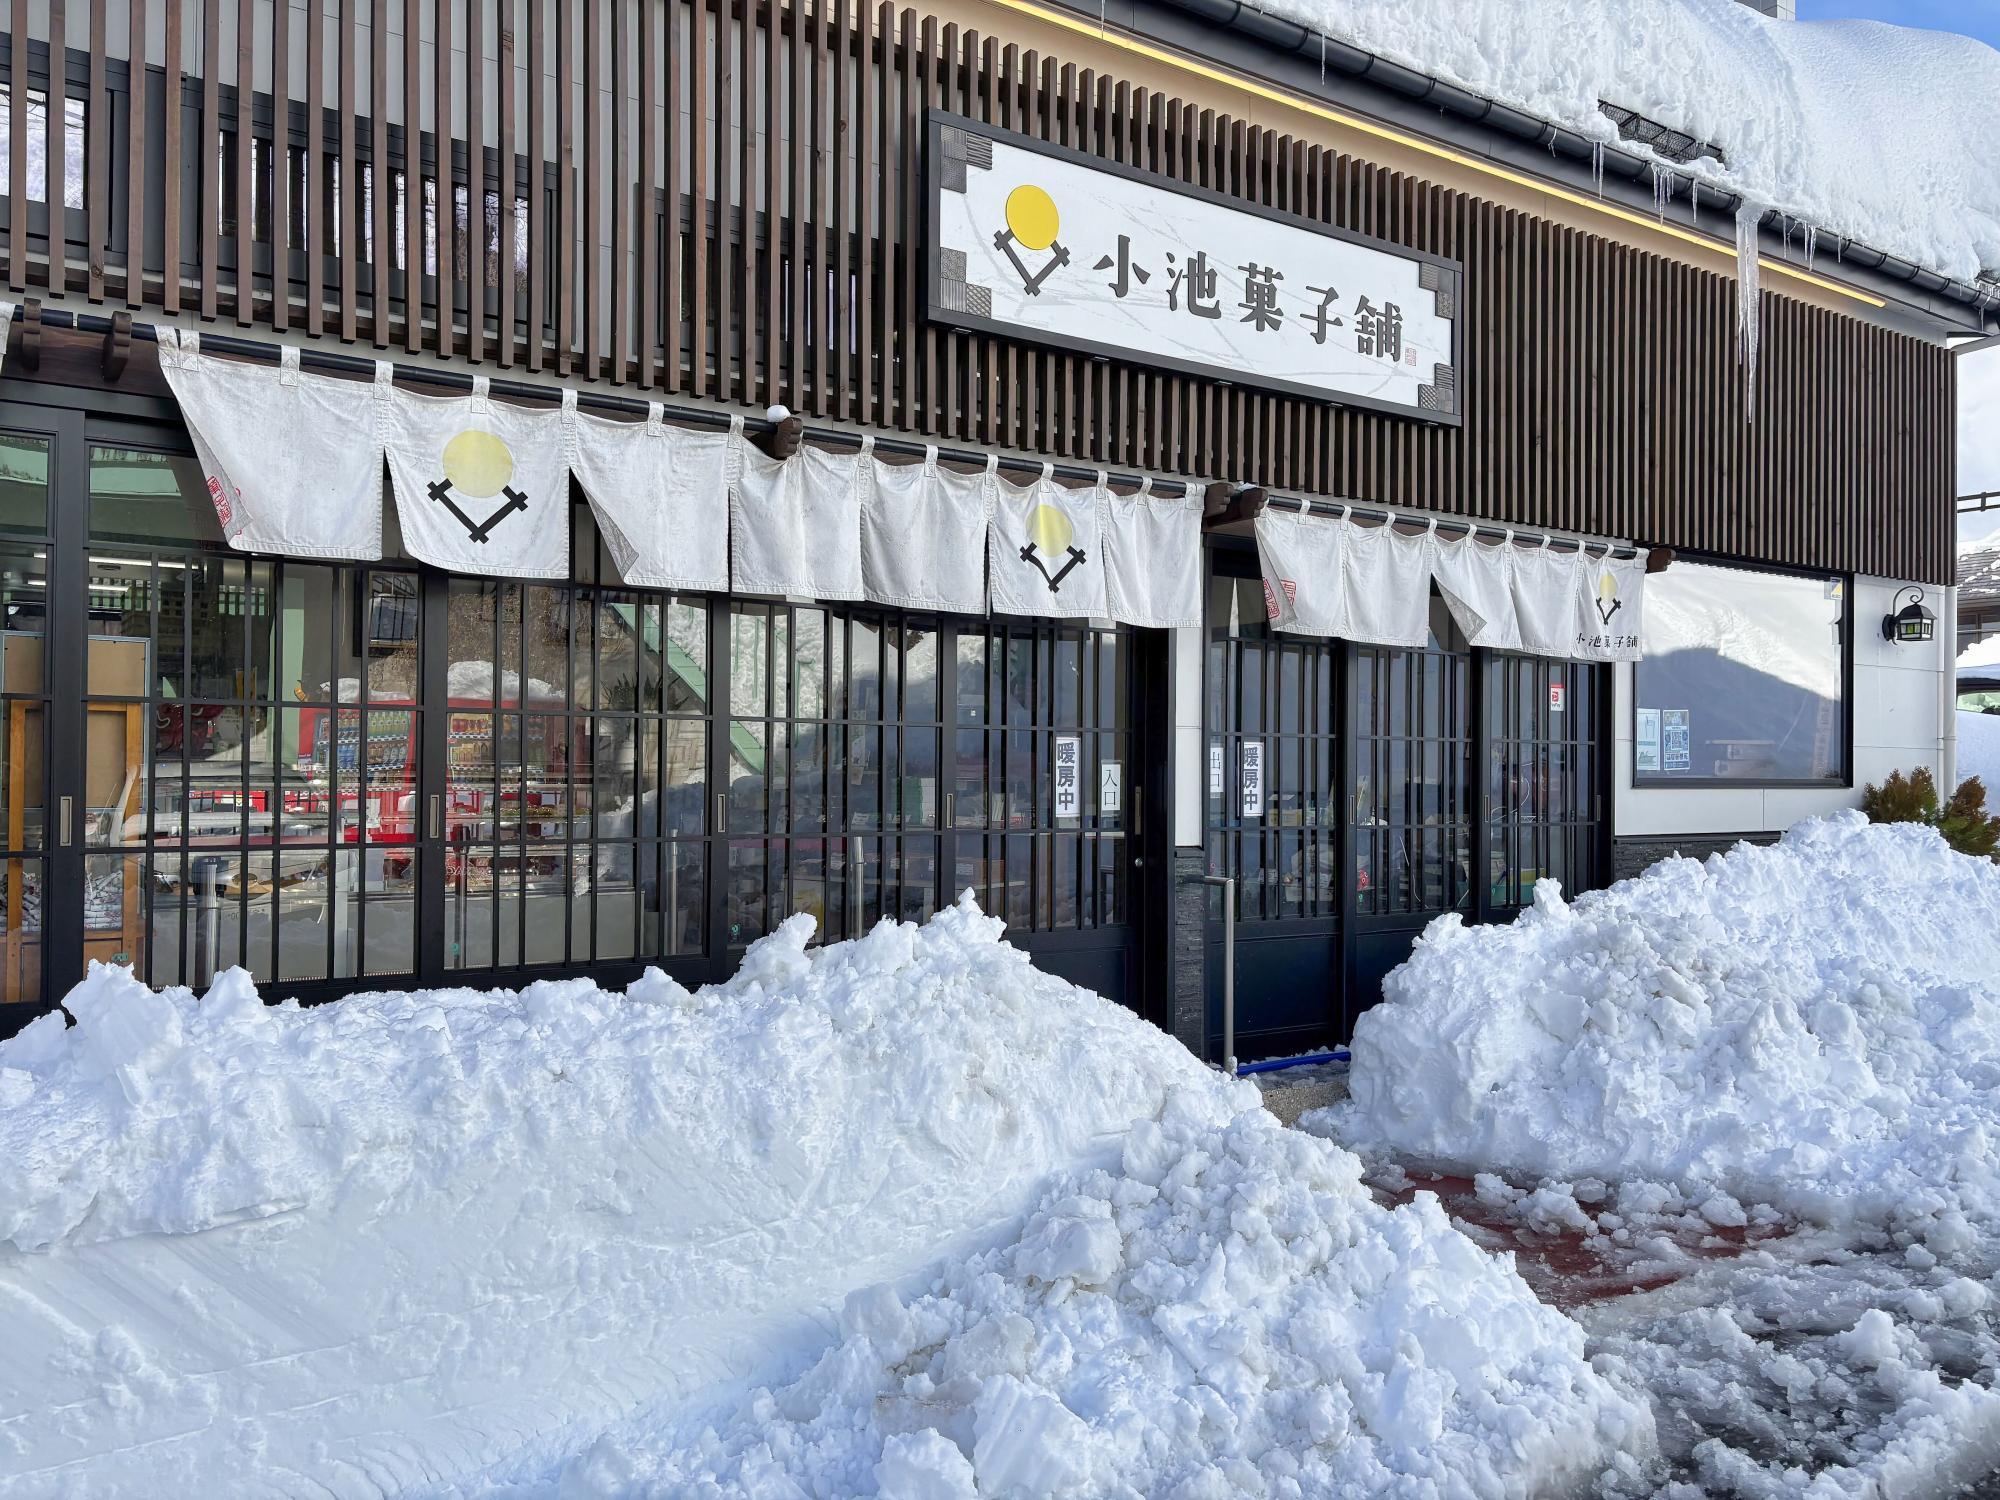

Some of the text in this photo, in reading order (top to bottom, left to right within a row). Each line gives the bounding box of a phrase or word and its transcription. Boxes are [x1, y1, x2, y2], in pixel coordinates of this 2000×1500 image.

[1093, 234, 1403, 362] 小池菓子舗
[1057, 742, 1075, 810] 暖房中
[1103, 769, 1117, 806] 入口
[1243, 747, 1259, 811] 暖房中
